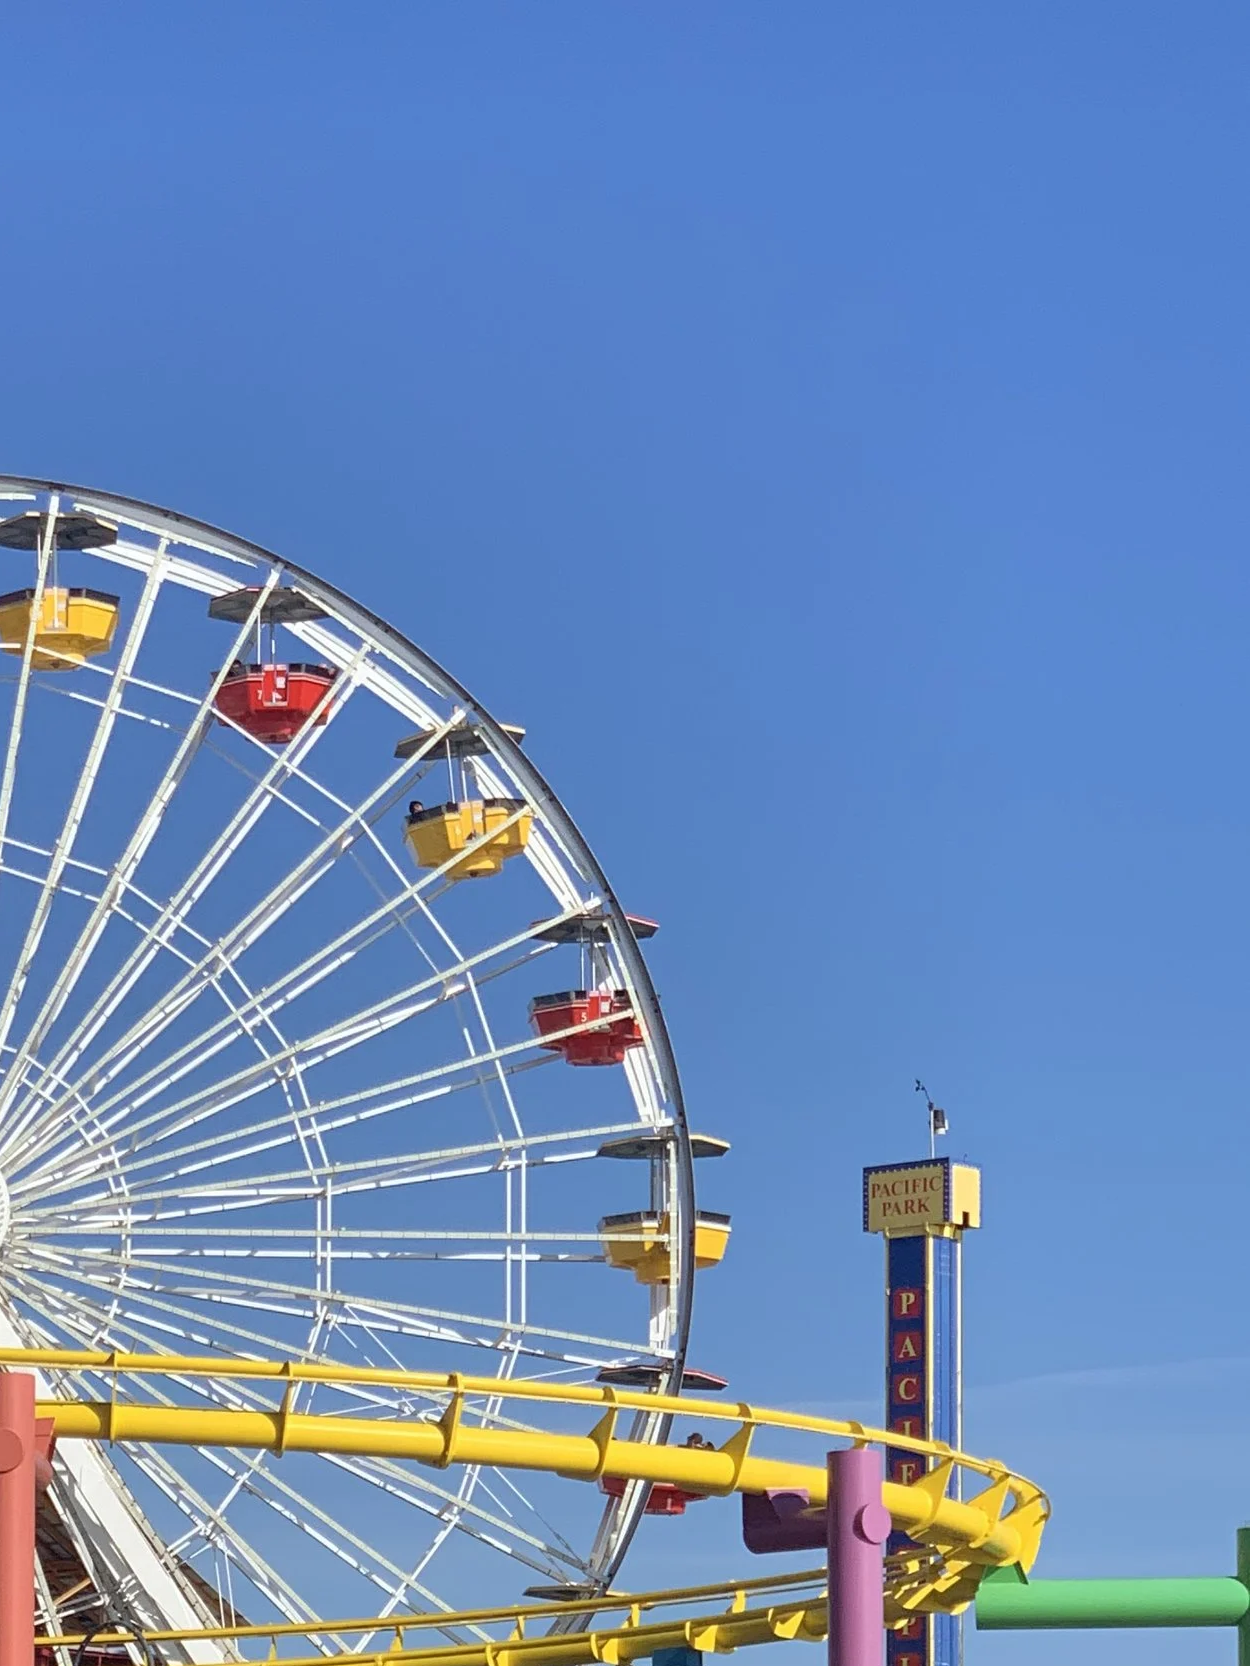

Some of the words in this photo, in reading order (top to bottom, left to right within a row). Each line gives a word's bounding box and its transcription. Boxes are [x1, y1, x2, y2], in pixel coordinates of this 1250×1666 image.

[581, 1012, 587, 1022] 5
[871, 1175, 942, 1200] PACIFIC
[882, 1196, 931, 1217] PARK
[898, 1292, 918, 1487] PACIF
